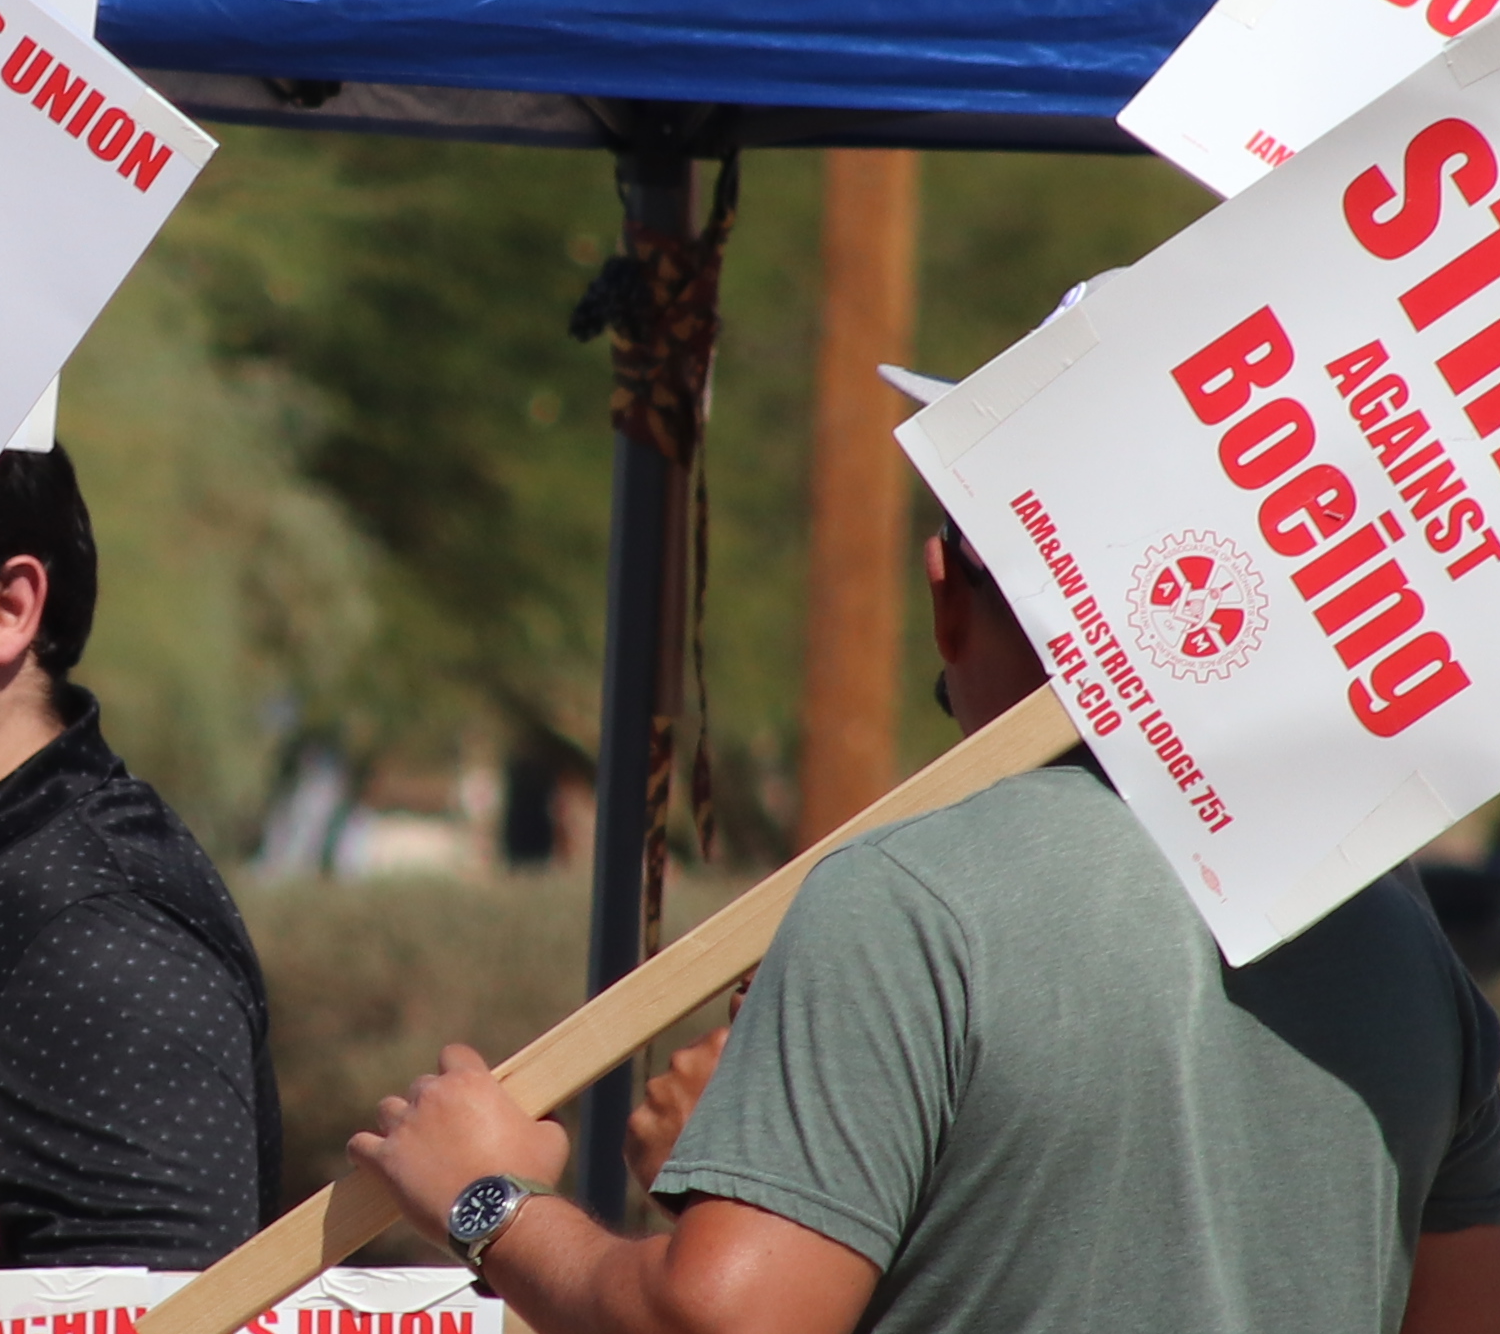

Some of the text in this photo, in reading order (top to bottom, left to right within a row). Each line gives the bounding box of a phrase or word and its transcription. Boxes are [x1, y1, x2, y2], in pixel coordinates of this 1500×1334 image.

[1, 37, 173, 192] UNION
[1171, 306, 1471, 738] Boeing
[1009, 488, 1089, 599] IAM&AW
[1071, 595, 1155, 712] DISTRICT
[1138, 710, 1205, 793] LODGE
[1190, 785, 1235, 834] 751
[1046, 631, 1122, 738] AFL-CIO
